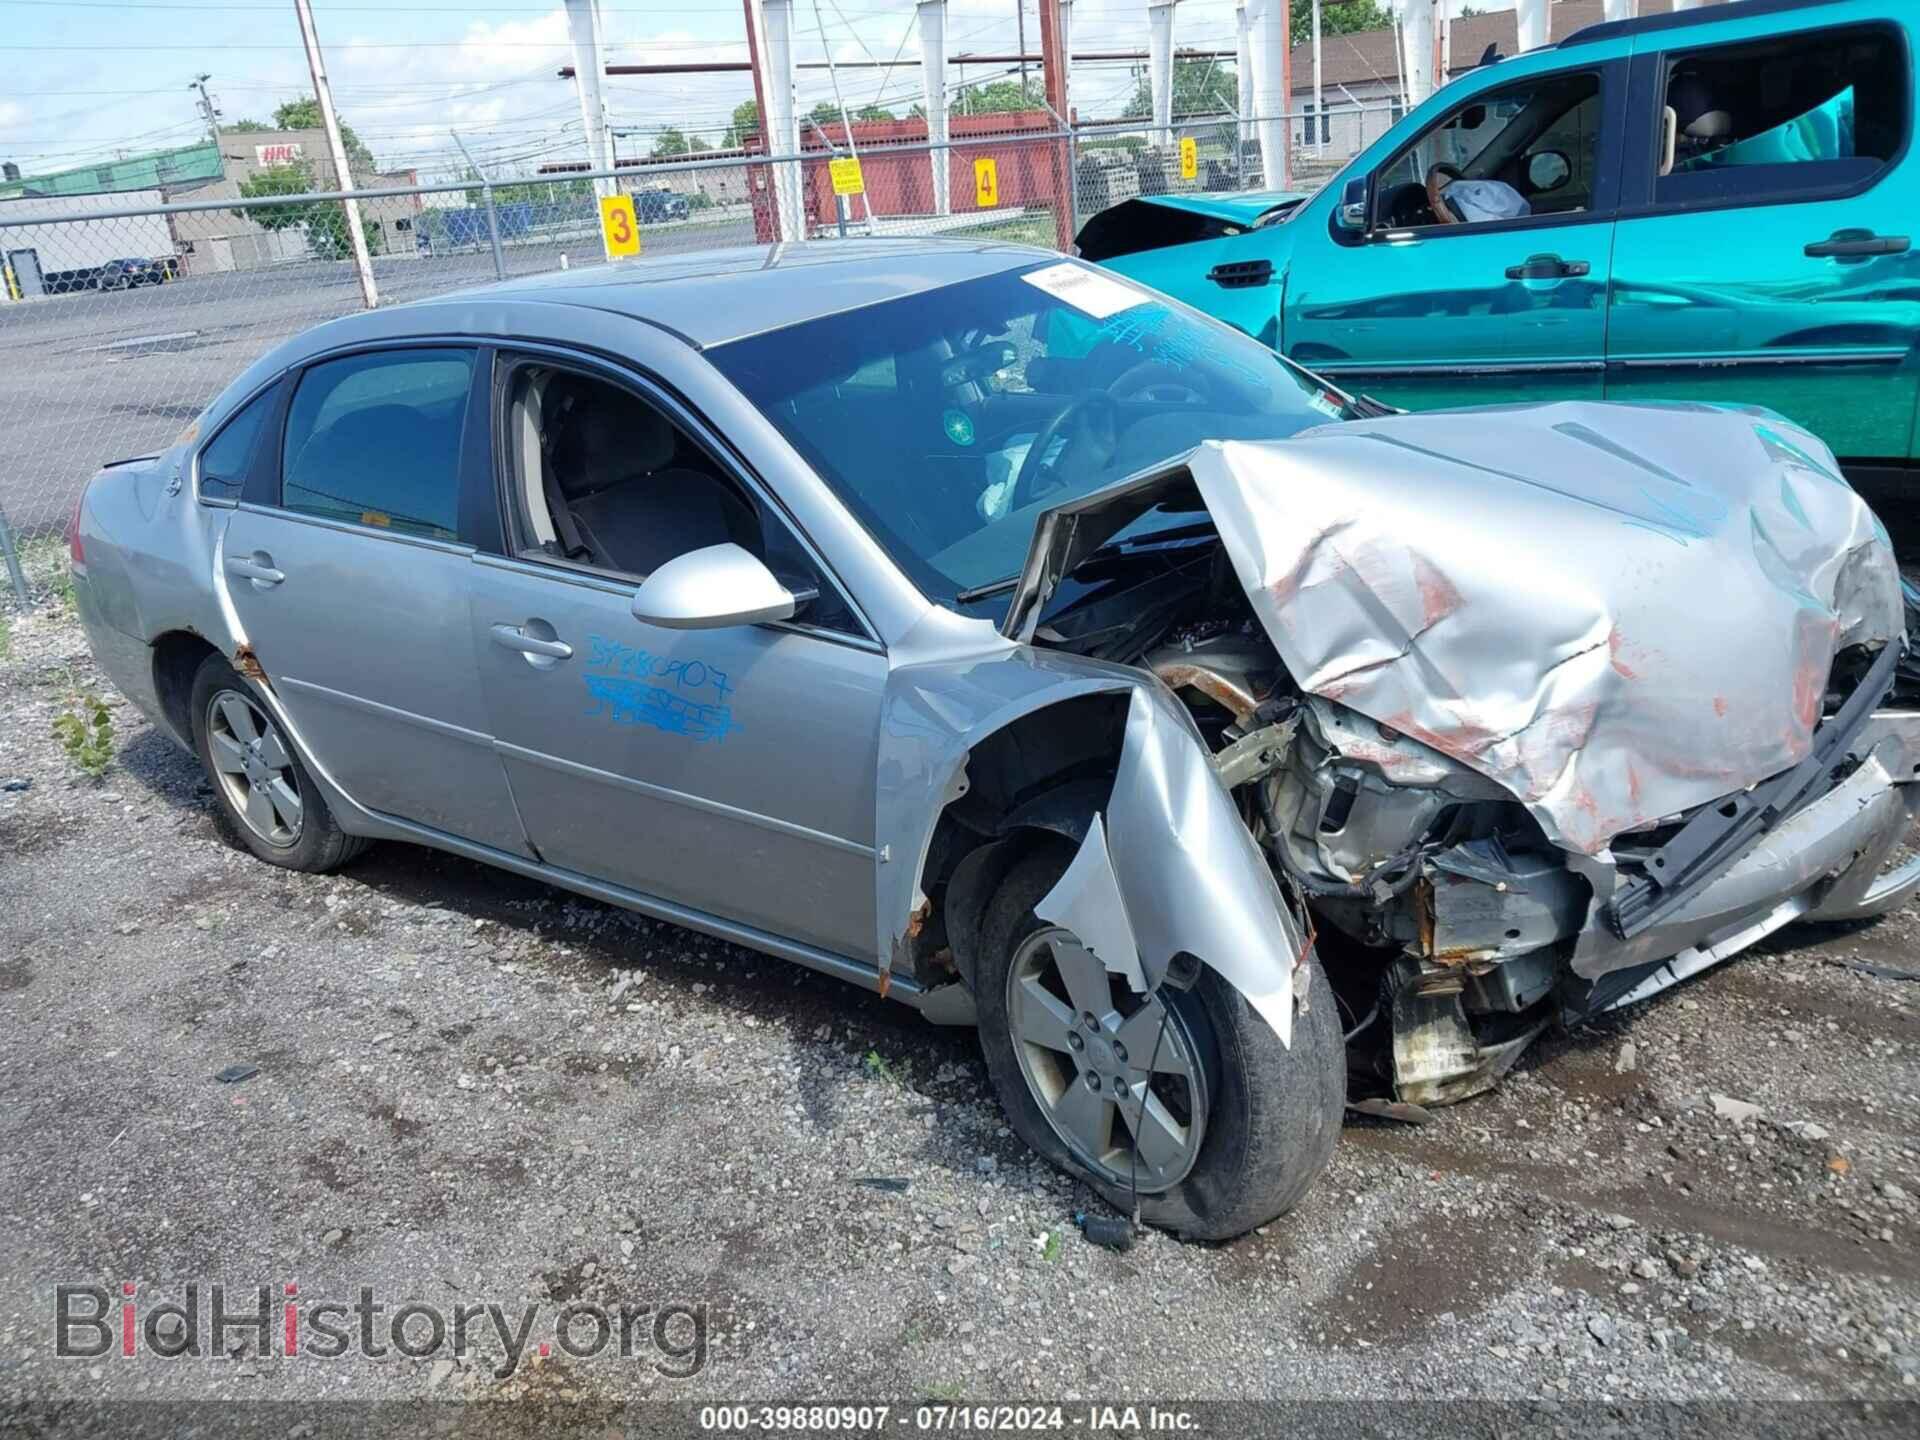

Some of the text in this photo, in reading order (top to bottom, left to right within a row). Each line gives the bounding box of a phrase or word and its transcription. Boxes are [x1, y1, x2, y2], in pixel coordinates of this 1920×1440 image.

[1185, 147, 1194, 169] 5
[981, 170, 993, 196] 4
[610, 208, 631, 243] 3
